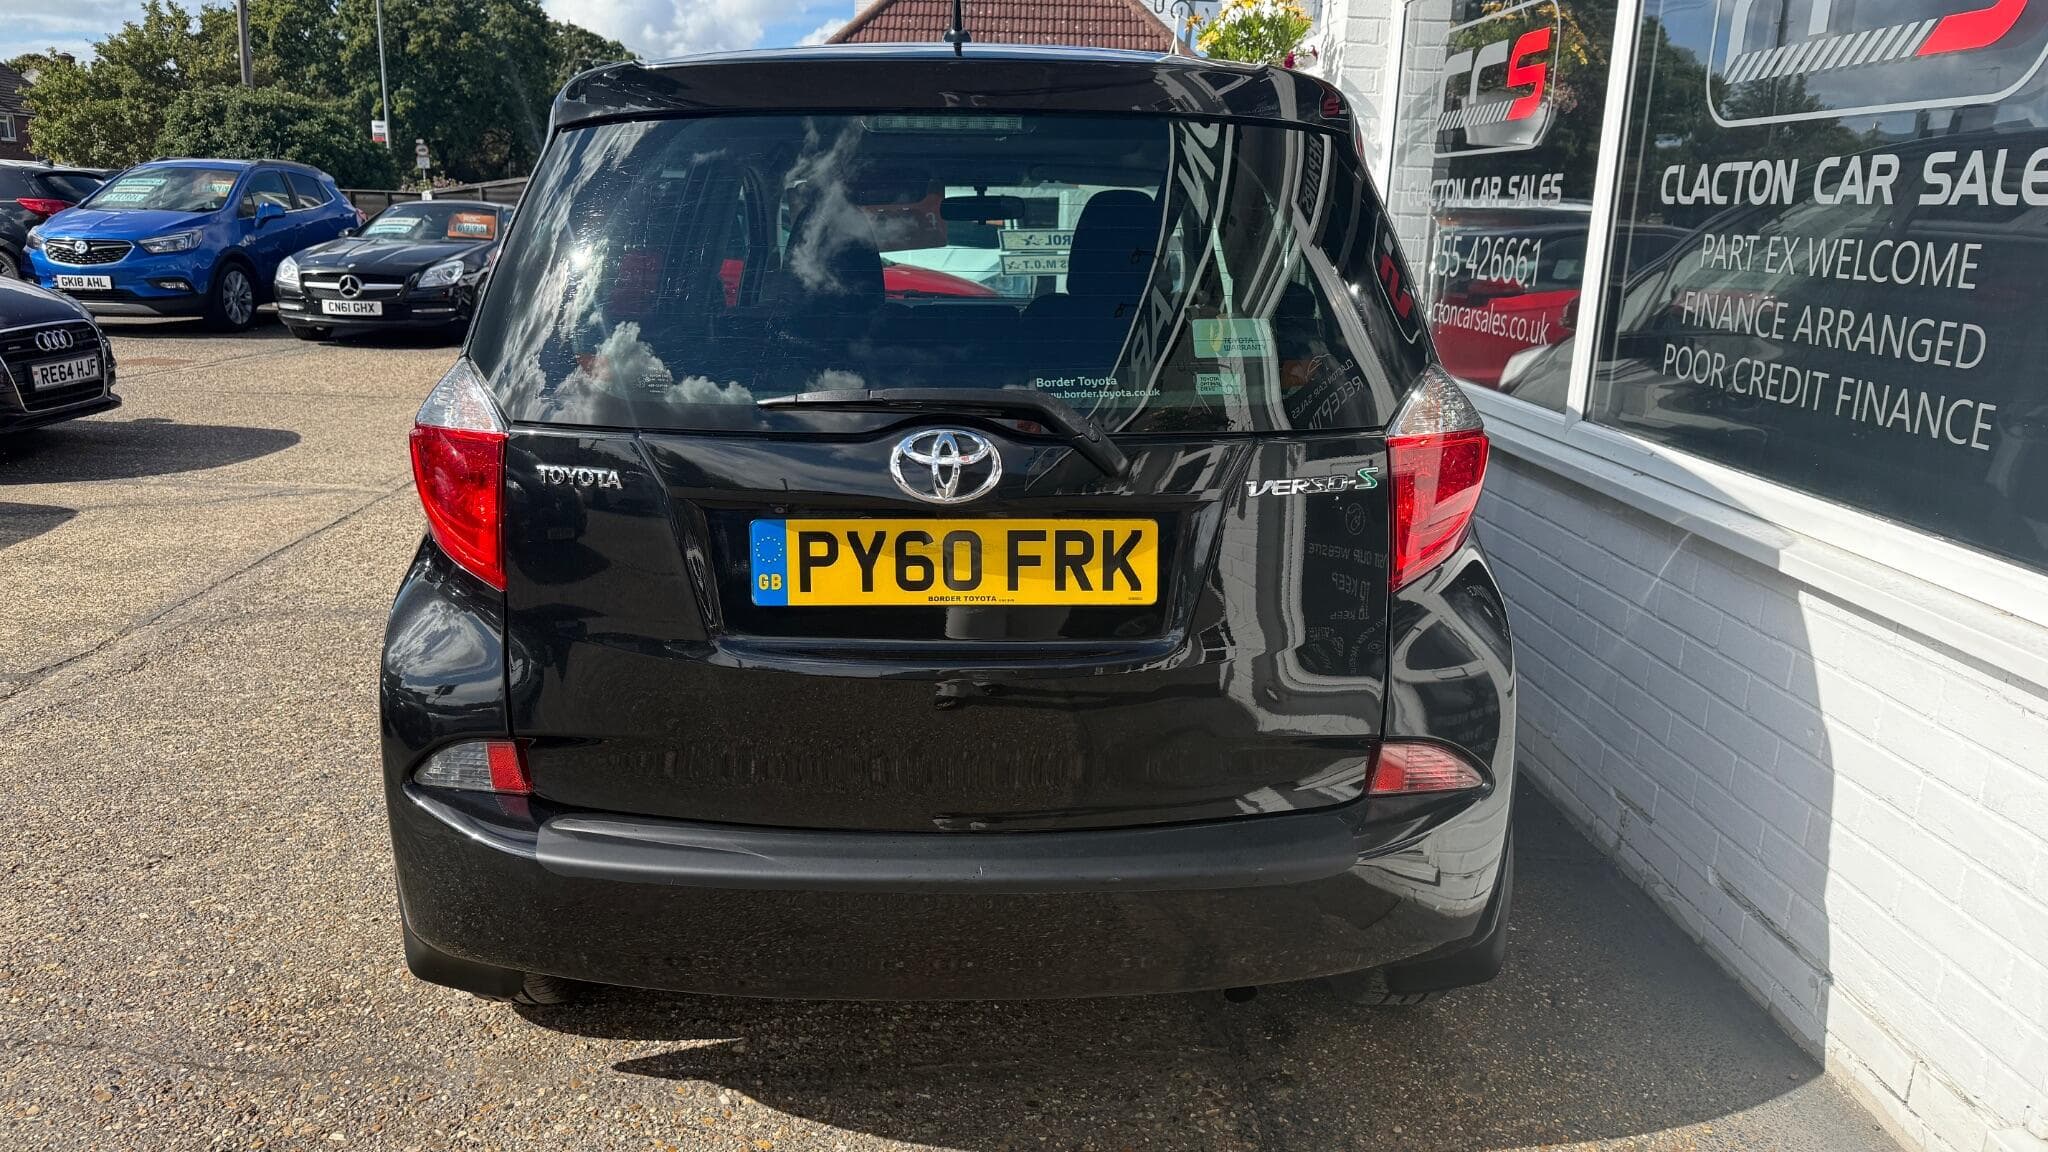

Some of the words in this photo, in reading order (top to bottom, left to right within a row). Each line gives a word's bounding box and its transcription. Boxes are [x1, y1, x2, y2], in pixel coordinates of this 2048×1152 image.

[1408, 178, 1466, 209] CLACTON
[1470, 176, 1502, 207] CAR
[1508, 173, 1564, 206] SALES
[1660, 159, 1799, 205] CLACTON
[1814, 154, 1900, 205] CAR
[1919, 146, 2048, 206] SALE
[1465, 236, 1542, 287] 426661
[1701, 233, 1760, 272] PART
[1766, 236, 1798, 275] EX
[1808, 237, 1983, 290] WELCOME
[87, 277, 107, 288] AHL
[328, 301, 351, 312] CN61
[353, 302, 375, 313] GHX
[1432, 302, 1551, 346] ctoncarsales.co.uk
[1682, 291, 1788, 341] FINANCE
[1793, 304, 1986, 370] ARRANGED
[40, 362, 75, 385] RE64
[76, 358, 97, 378] HJF
[1036, 377, 1075, 387] Border
[1077, 376, 1118, 389] Toyota
[1662, 343, 1725, 390] POOR
[1732, 356, 1829, 411] CREDIT
[1835, 375, 1996, 452] FINANCE
[535, 464, 623, 490] TOYOTA
[1245, 467, 1379, 497] VERSO-S
[798, 529, 983, 593] PY60
[1007, 530, 1143, 592] FRK
[758, 573, 782, 590] GB
